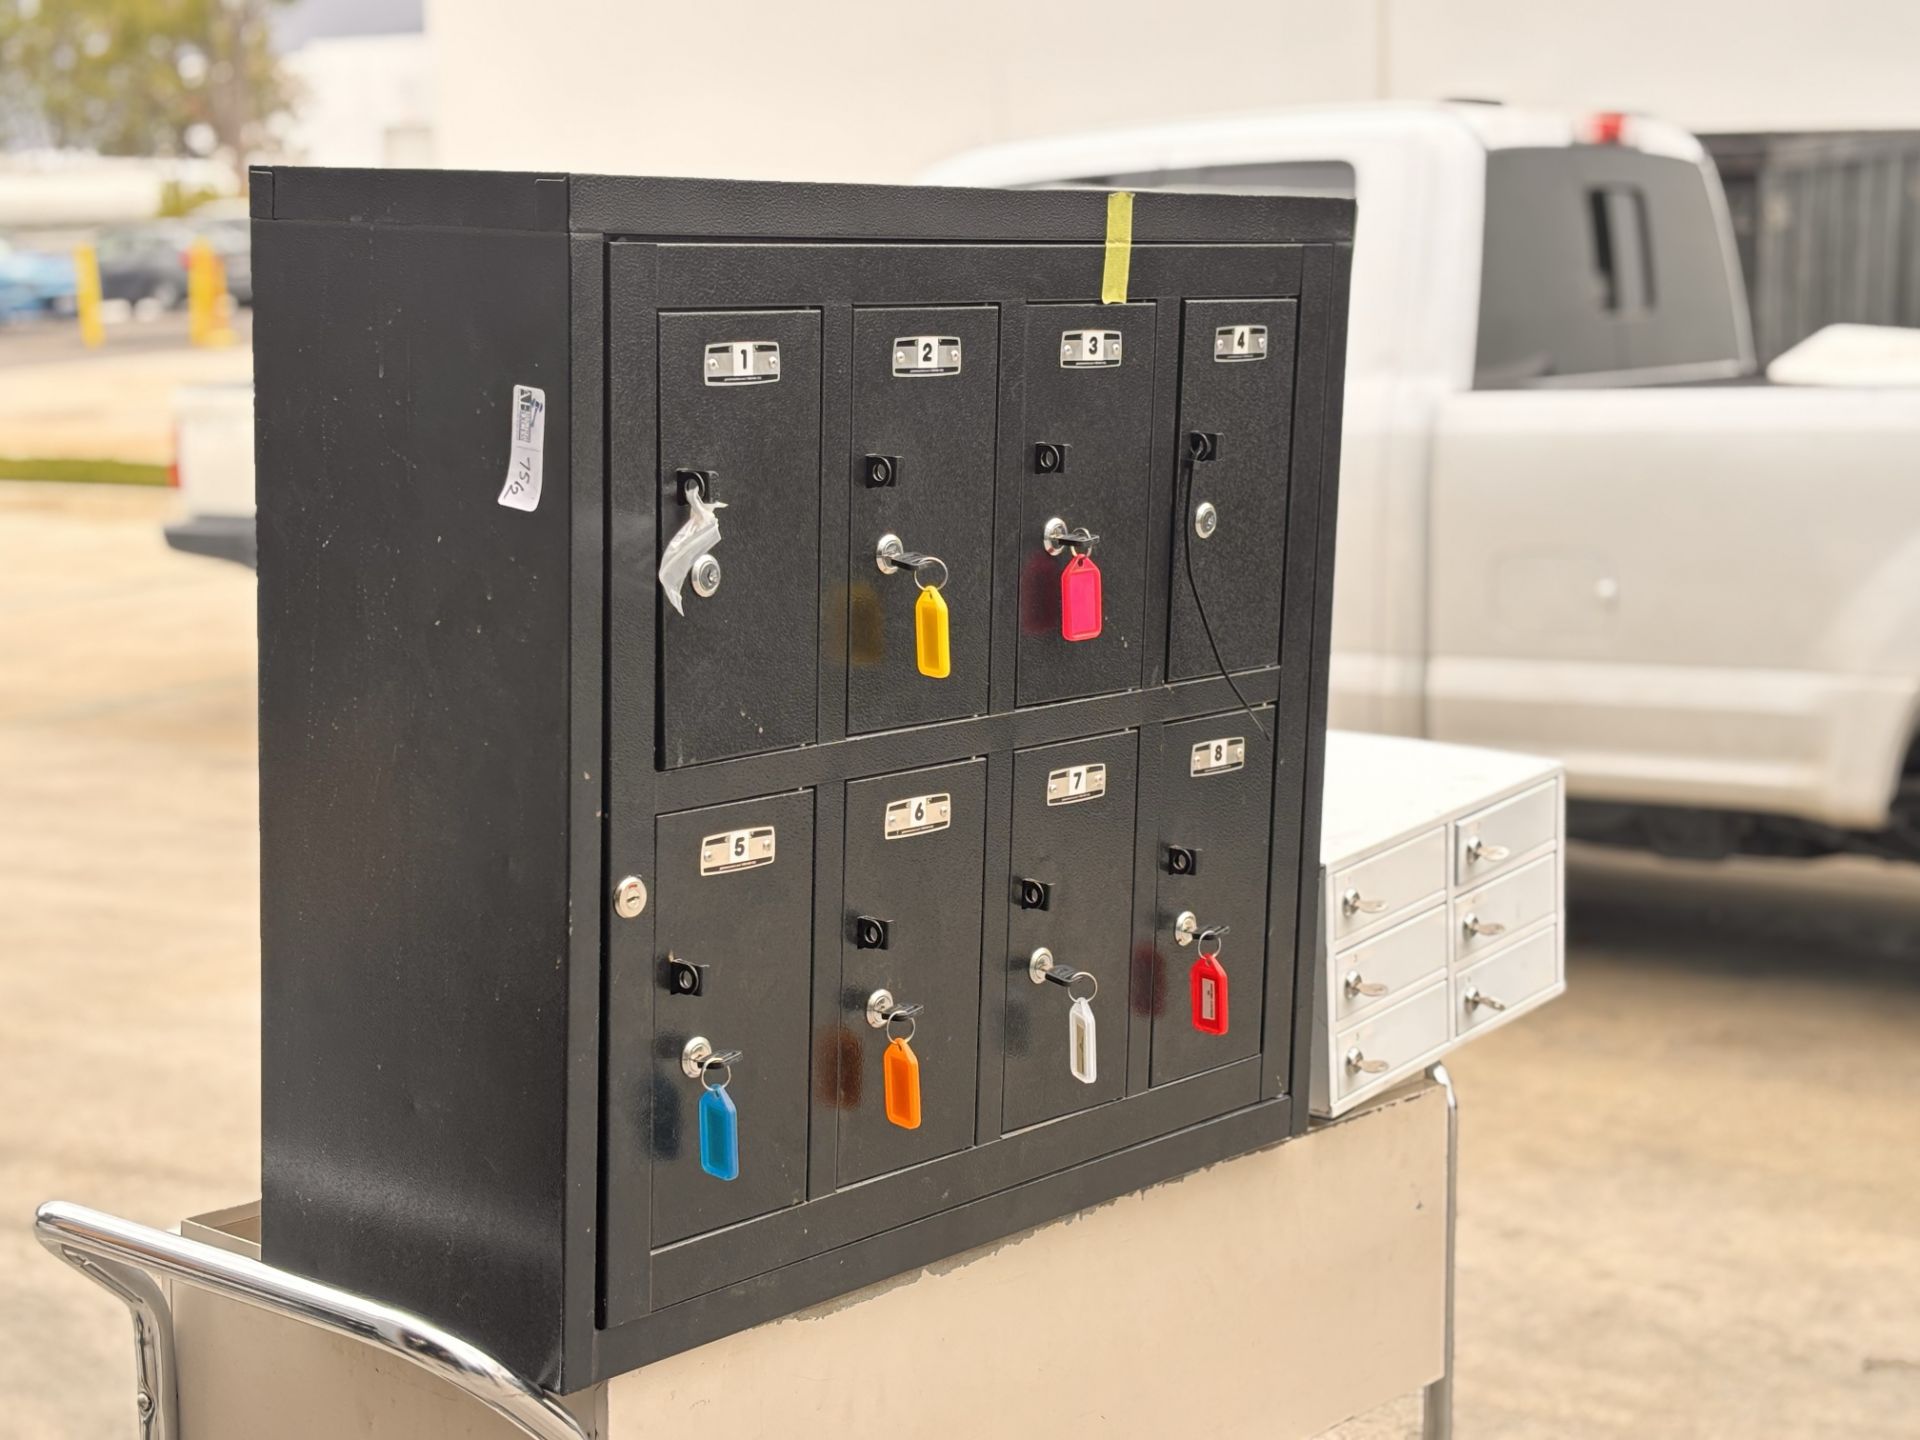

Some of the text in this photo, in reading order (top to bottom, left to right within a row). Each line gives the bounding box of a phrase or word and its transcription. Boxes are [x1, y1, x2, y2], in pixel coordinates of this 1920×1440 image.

[1088, 336, 1098, 355] 3
[1237, 331, 1245, 348] 4
[740, 349, 748, 370] 1
[922, 342, 933, 362] 2
[1214, 744, 1223, 762] 8
[1073, 771, 1082, 789] 7
[914, 802, 924, 821] 6
[734, 836, 745, 857] 5
